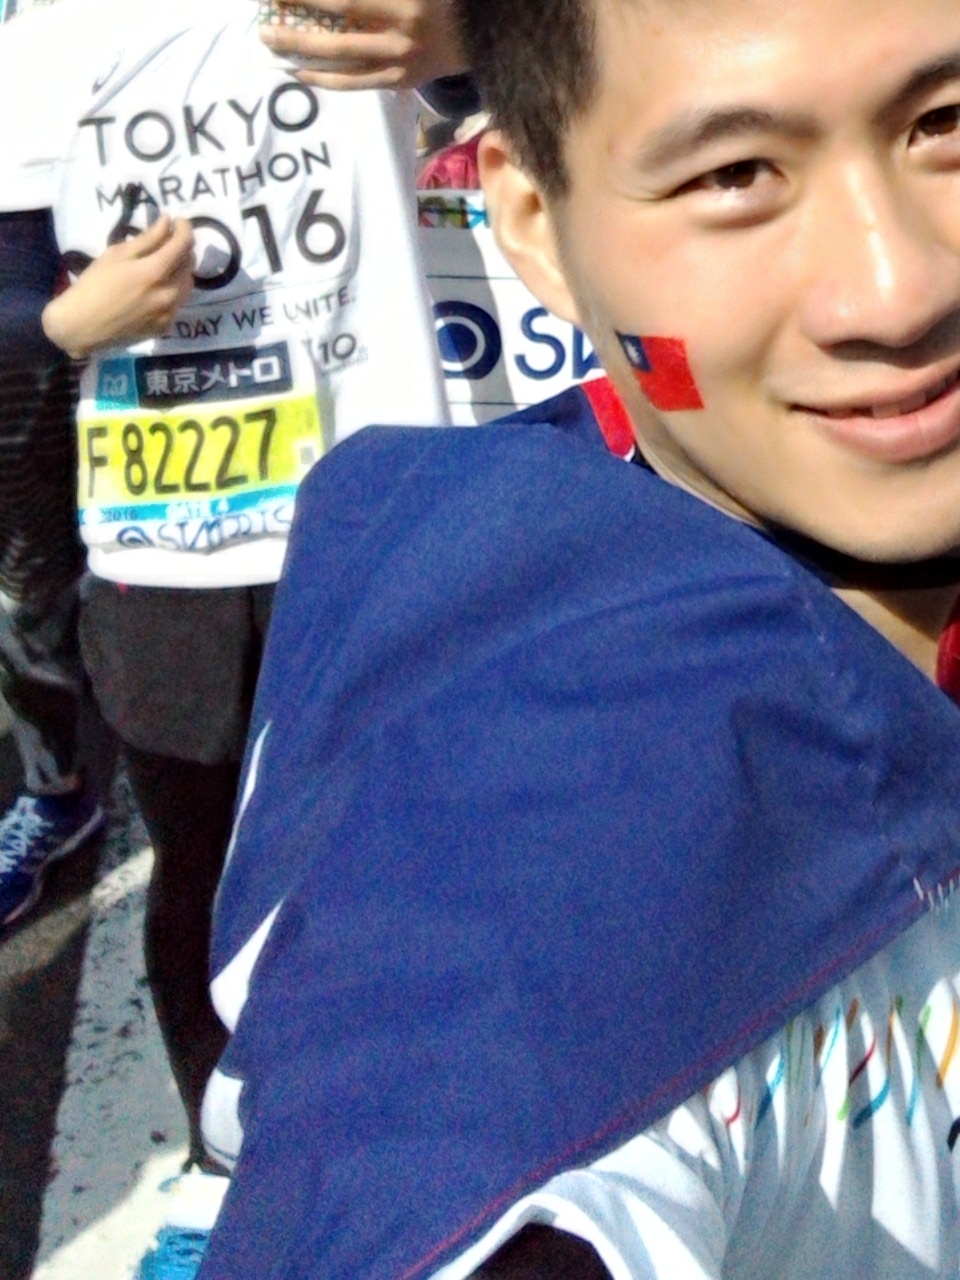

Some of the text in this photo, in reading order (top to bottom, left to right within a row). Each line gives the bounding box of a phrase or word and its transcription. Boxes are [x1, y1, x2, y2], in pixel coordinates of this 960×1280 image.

[78, 82, 319, 166] TOKYO
[95, 141, 332, 211] MARATHON
[176, 315, 224, 340] DAY
[233, 306, 274, 331] WE
[144, 355, 281, 397] 東京メトロ
